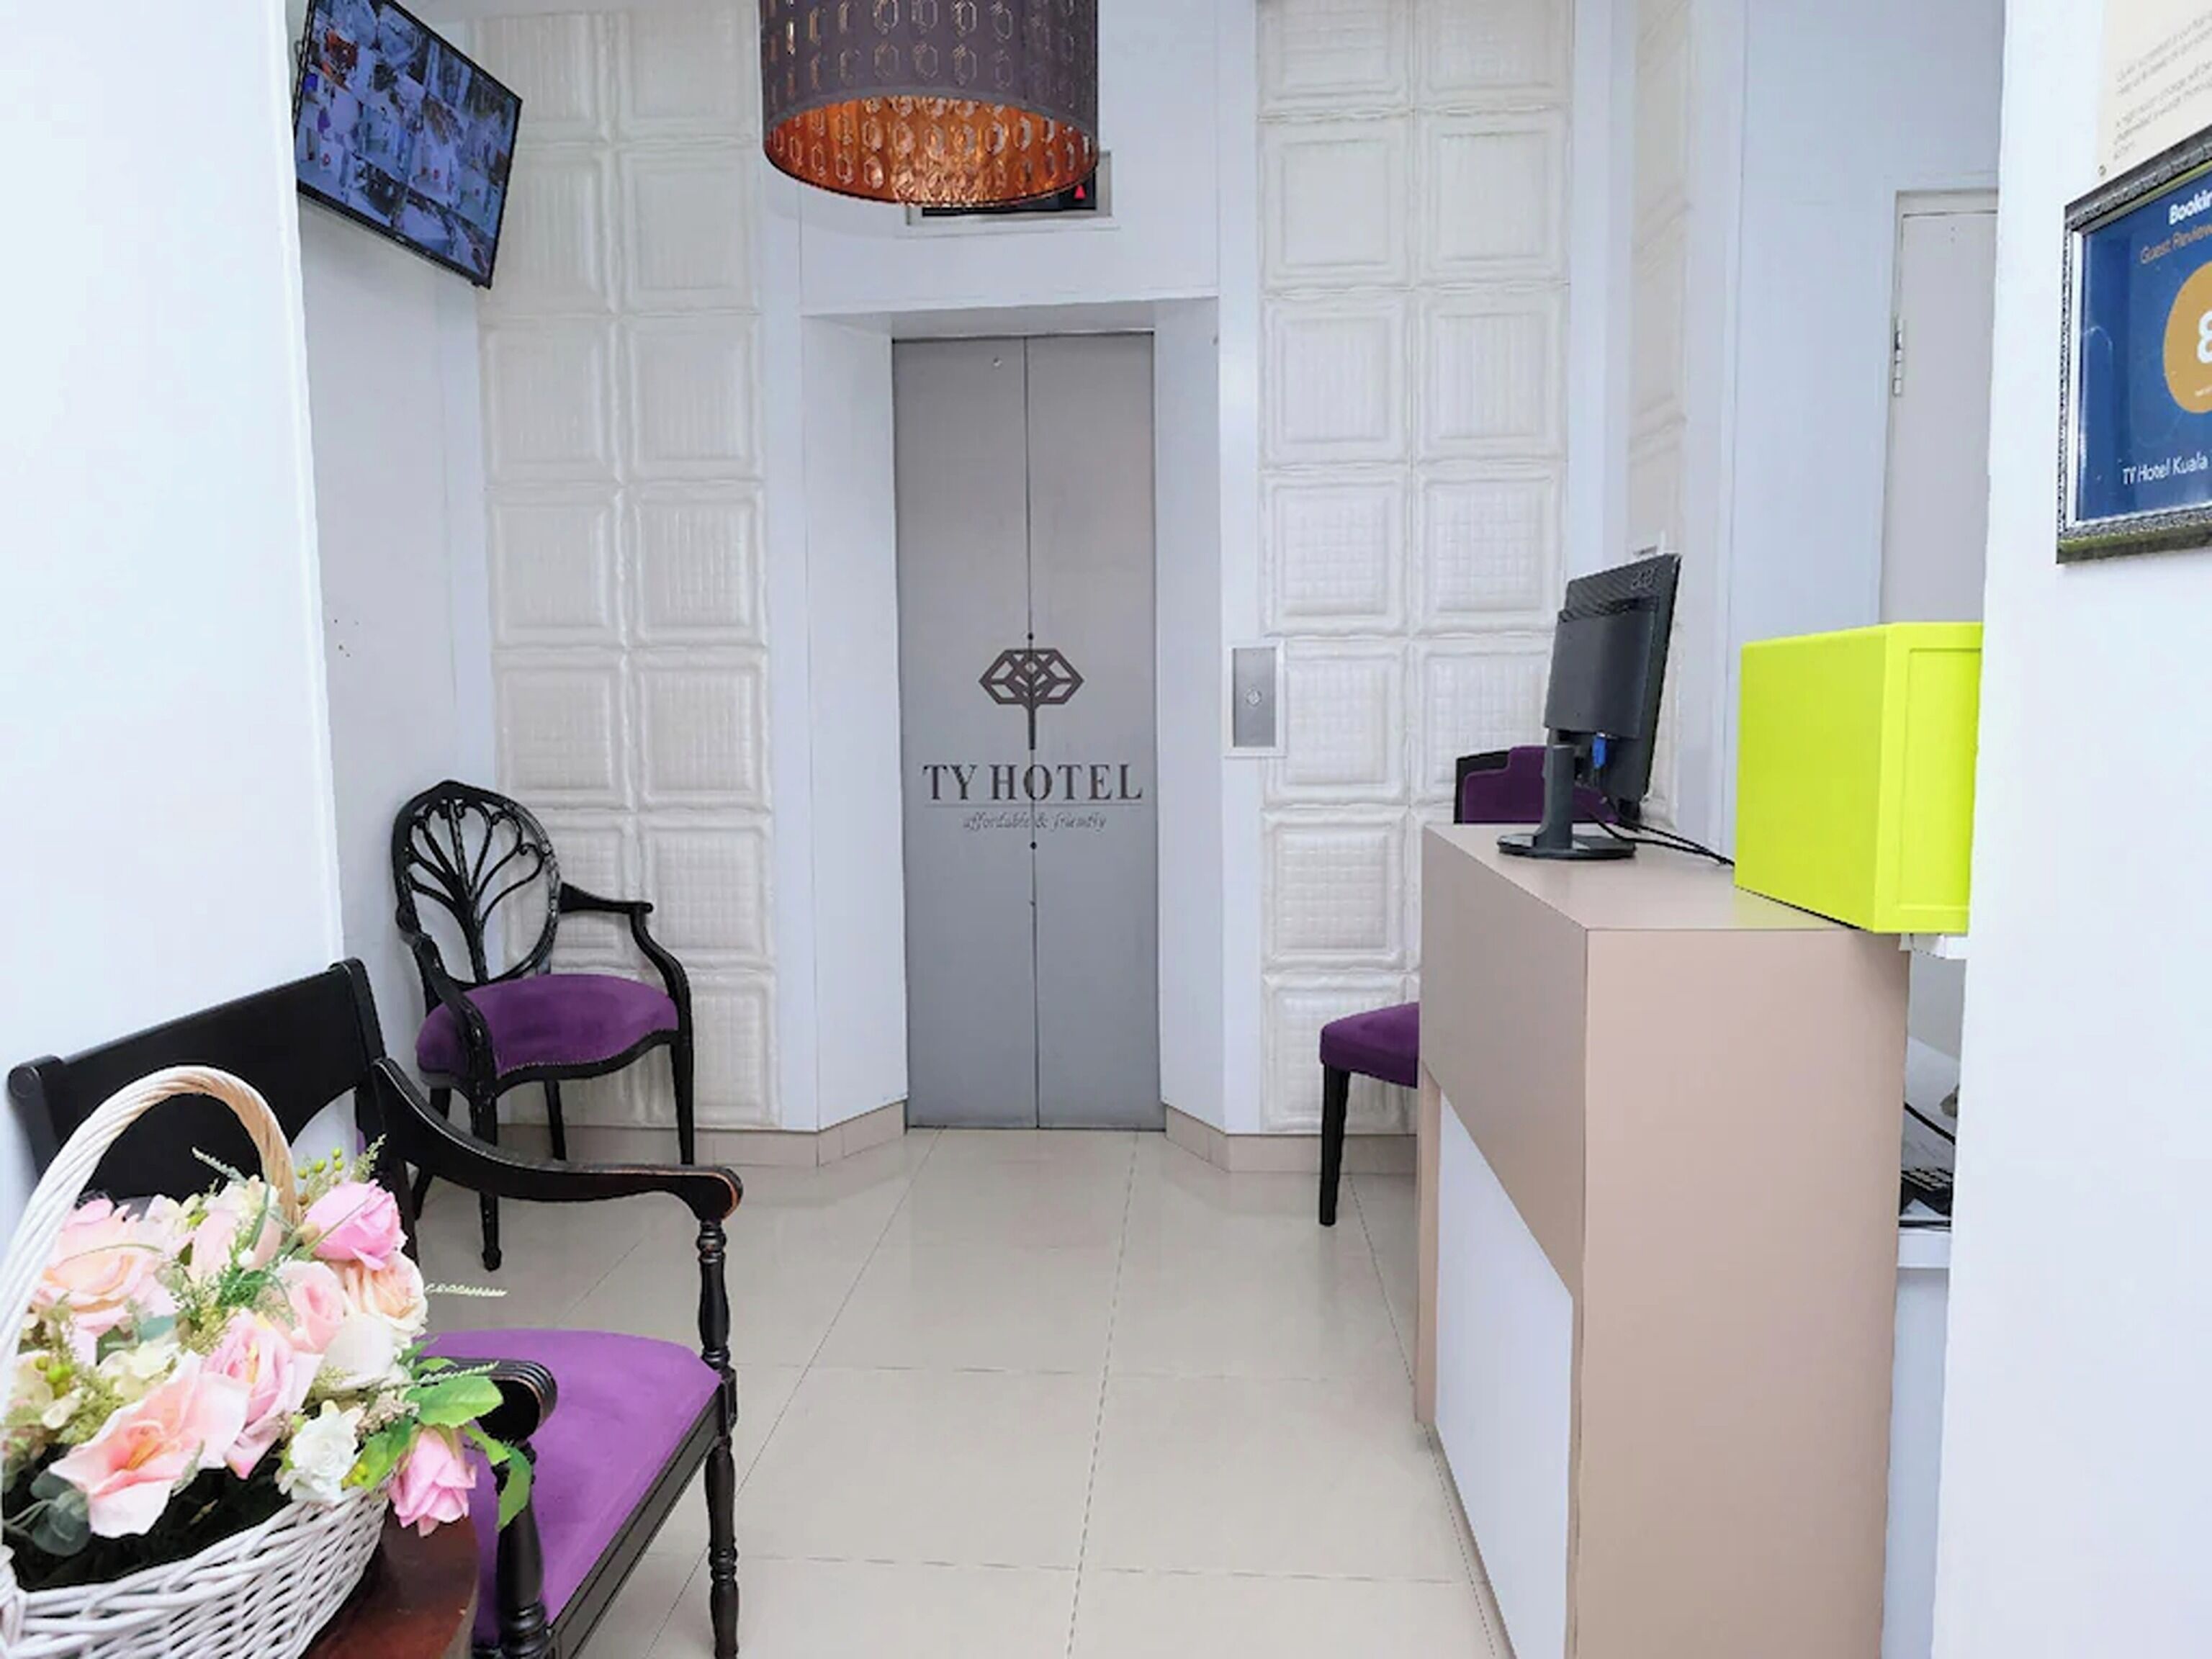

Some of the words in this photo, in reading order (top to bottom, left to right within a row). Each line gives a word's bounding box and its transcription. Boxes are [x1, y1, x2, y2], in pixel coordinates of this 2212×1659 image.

[2141, 240, 2171, 264] Guest
[2123, 467, 2136, 485] TY
[2137, 458, 2170, 482] Hotel
[2173, 451, 2208, 475] Kuala
[922, 764, 977, 800] TY
[989, 764, 1143, 801] HOTEL
[963, 811, 1030, 832] affordable
[1035, 811, 1047, 828] &
[1050, 811, 1106, 832] friendly
